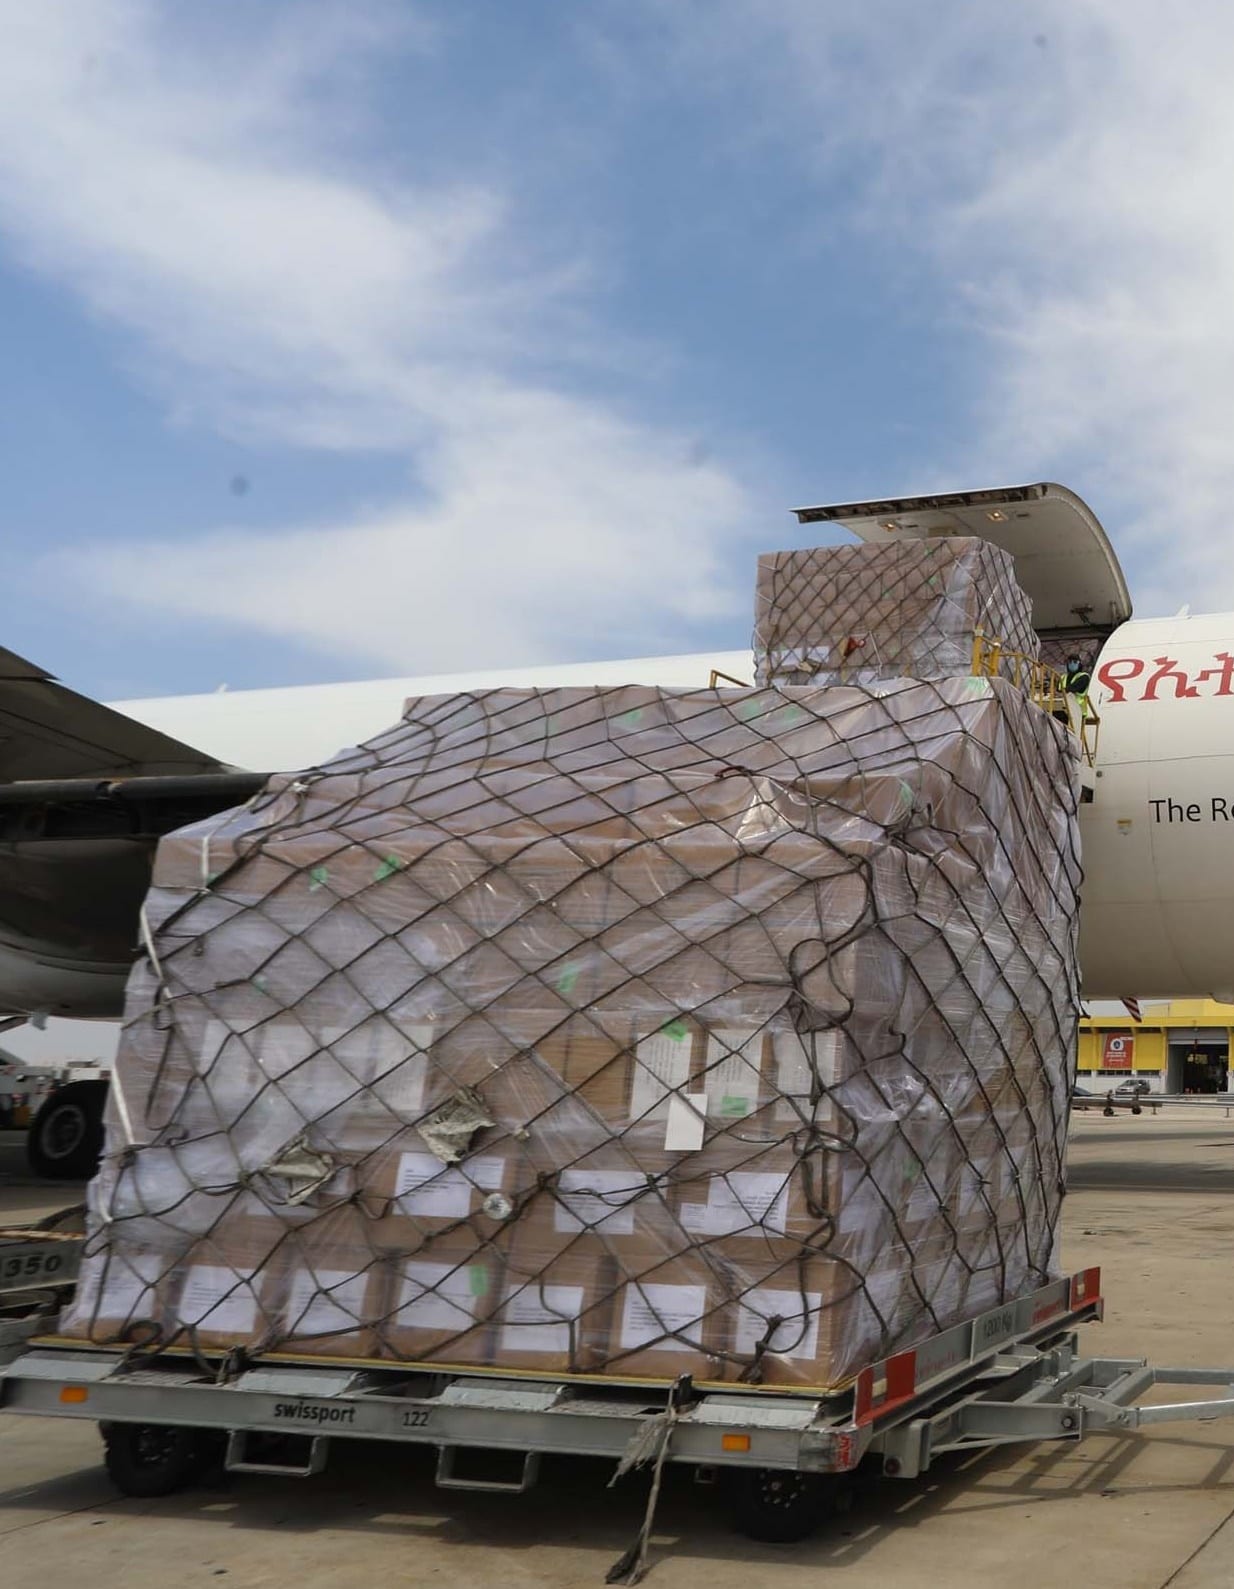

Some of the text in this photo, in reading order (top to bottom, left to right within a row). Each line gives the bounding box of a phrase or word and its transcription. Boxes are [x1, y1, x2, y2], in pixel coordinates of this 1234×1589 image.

[1149, 797, 1201, 823] The
[274, 1402, 429, 1427] swissport 122
